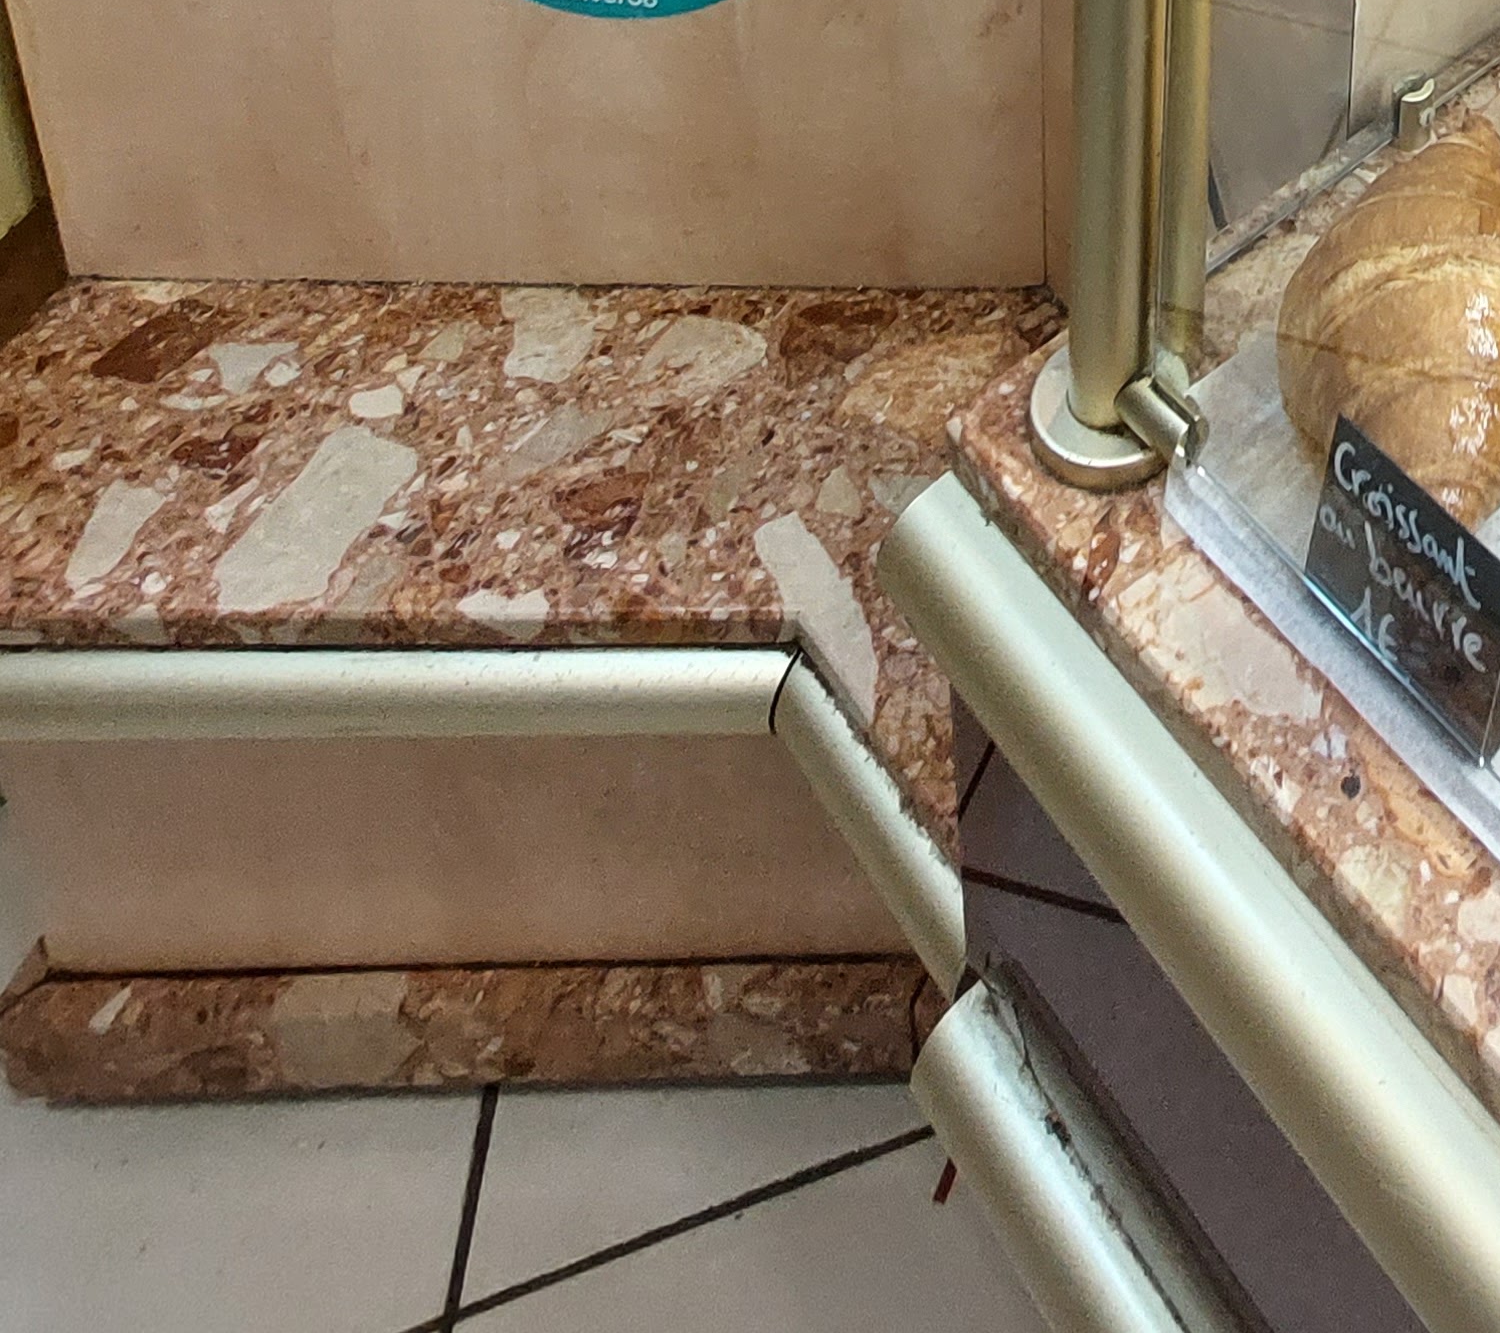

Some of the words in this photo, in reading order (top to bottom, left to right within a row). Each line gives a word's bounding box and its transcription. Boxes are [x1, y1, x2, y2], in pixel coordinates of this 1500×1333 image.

[1318, 503, 1356, 550] au
[1364, 521, 1487, 673] beurre
[1333, 441, 1482, 611] Croissant
